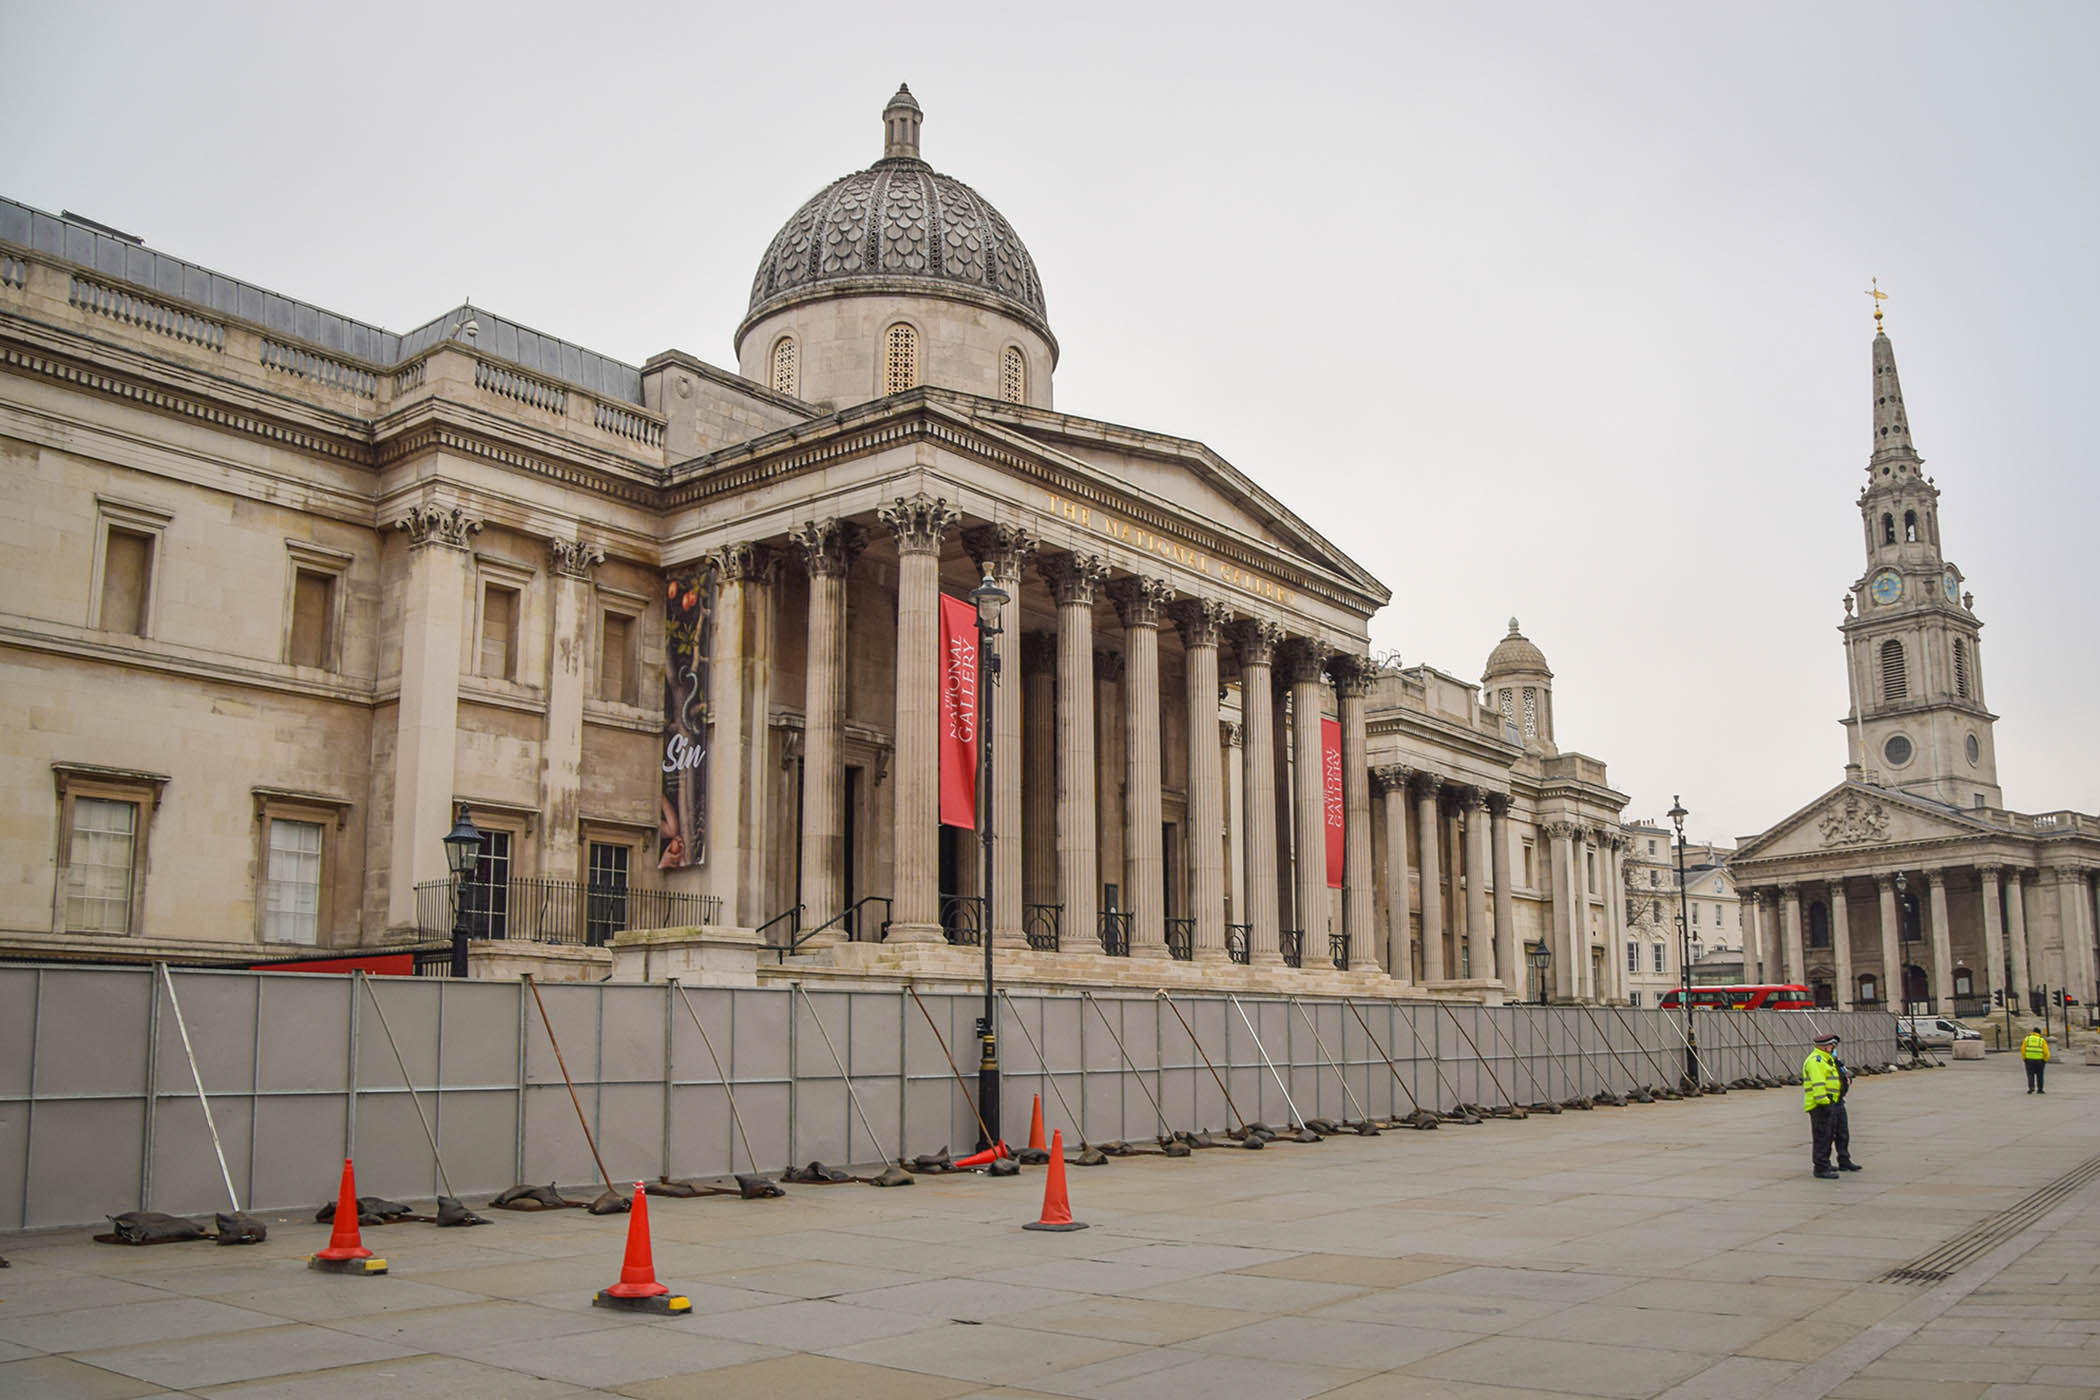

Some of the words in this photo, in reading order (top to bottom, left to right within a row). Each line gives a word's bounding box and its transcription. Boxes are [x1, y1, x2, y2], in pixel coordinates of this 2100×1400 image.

[1046, 493, 1091, 529] THE
[1104, 515, 1209, 574] NATIONAL
[1220, 565, 1297, 608] GALLERY
[948, 634, 962, 739] NATIONAL
[957, 636, 975, 743] GALLERY
[662, 733, 706, 773] Sin
[1326, 748, 1334, 825] NATIONAL
